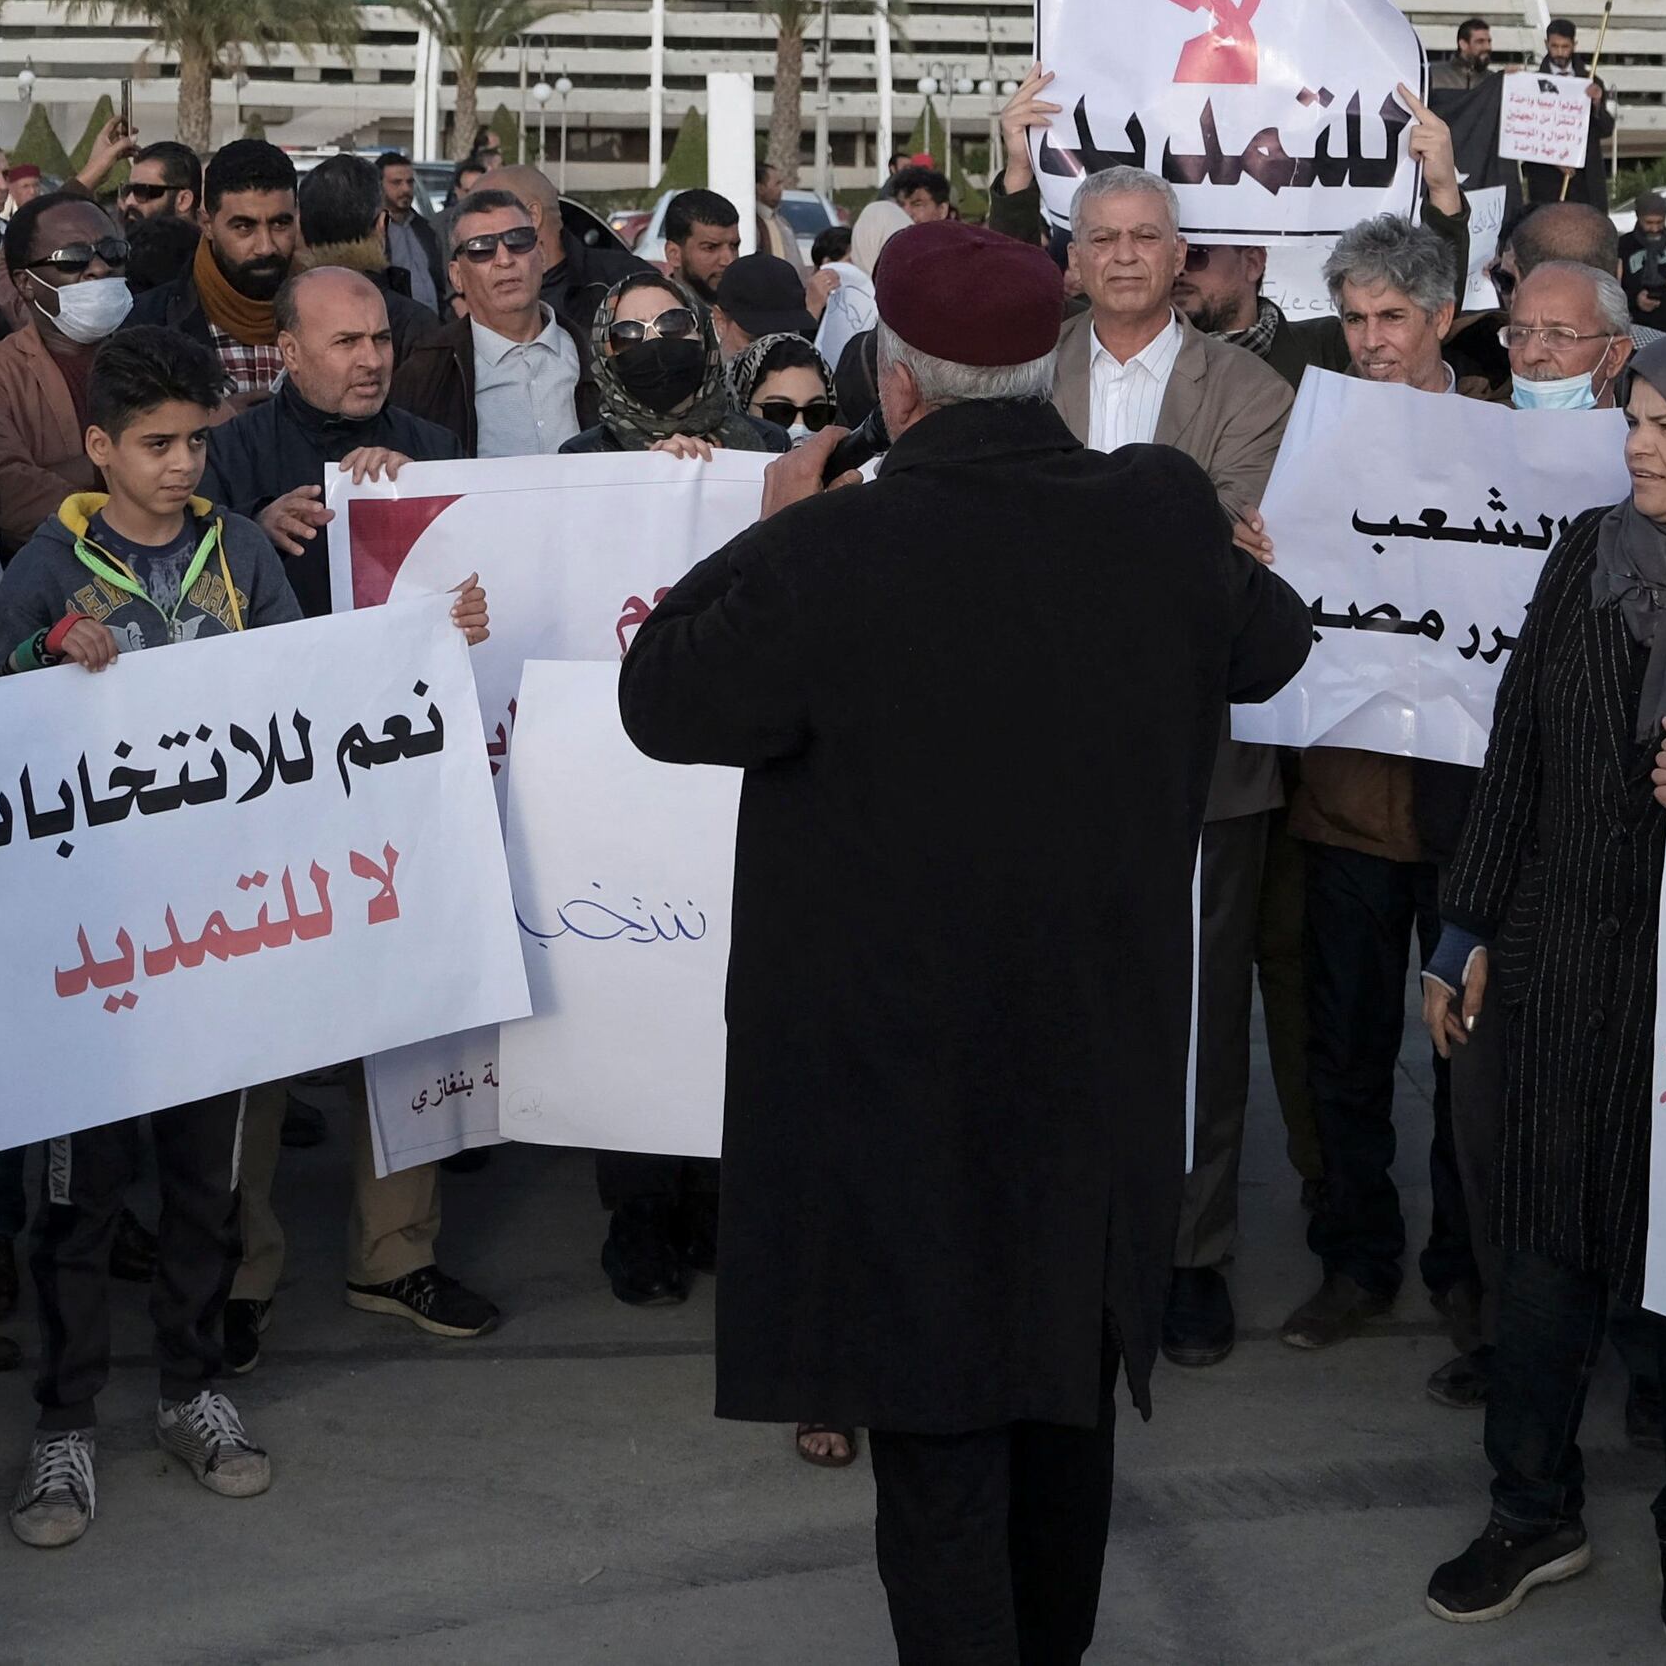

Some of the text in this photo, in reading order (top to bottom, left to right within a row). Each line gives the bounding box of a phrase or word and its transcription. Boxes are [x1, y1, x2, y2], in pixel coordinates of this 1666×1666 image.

[334, 679, 445, 799] نعم
[53, 839, 401, 1015] لا للتمديد
[410, 1070, 474, 1115] بنغازي
